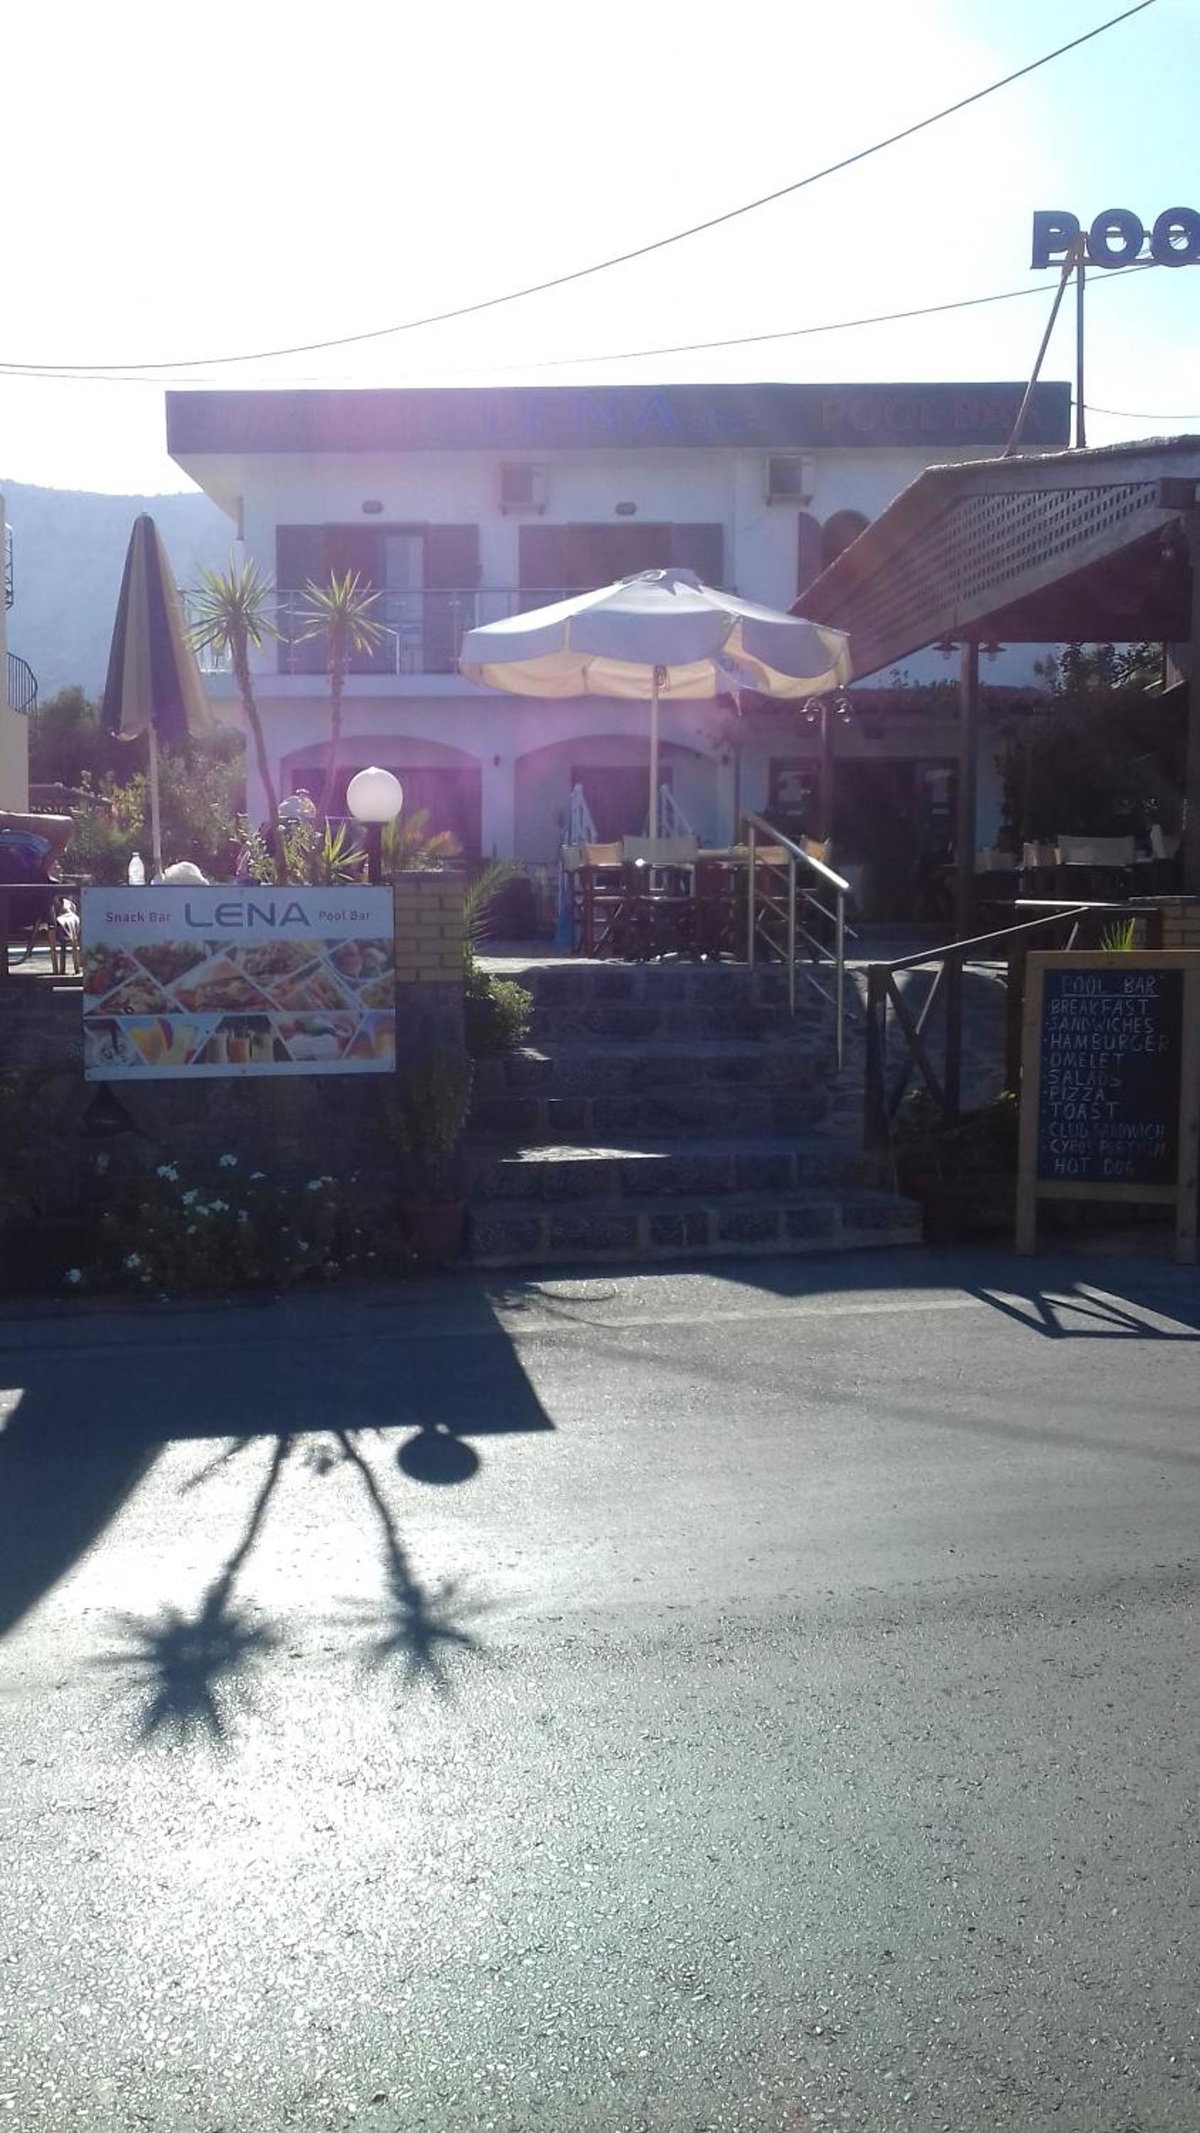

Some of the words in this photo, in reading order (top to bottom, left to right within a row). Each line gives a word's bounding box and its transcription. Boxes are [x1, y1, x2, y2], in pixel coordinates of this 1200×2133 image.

[105, 911, 145, 922] Snack
[149, 911, 171, 922] Bar
[184, 902, 311, 927] LENA
[319, 910, 345, 922] Pool
[350, 910, 371, 921] Bar
[1123, 975, 1157, 993] BAR
[1050, 999, 1149, 1016] BREAKFAST
[1048, 1016, 1155, 1033] SANDWICHES
[1050, 1033, 1169, 1052] HAMBURGER
[1050, 1052, 1125, 1070] OMELET
[1048, 1069, 1123, 1087] SALADS
[1049, 1086, 1105, 1101] PIZZA
[1048, 1101, 1120, 1120] TOAST
[1048, 1121, 1090, 1138] CLUB
[1054, 1157, 1091, 1174] HOT
[1103, 1158, 1136, 1176] DOG
